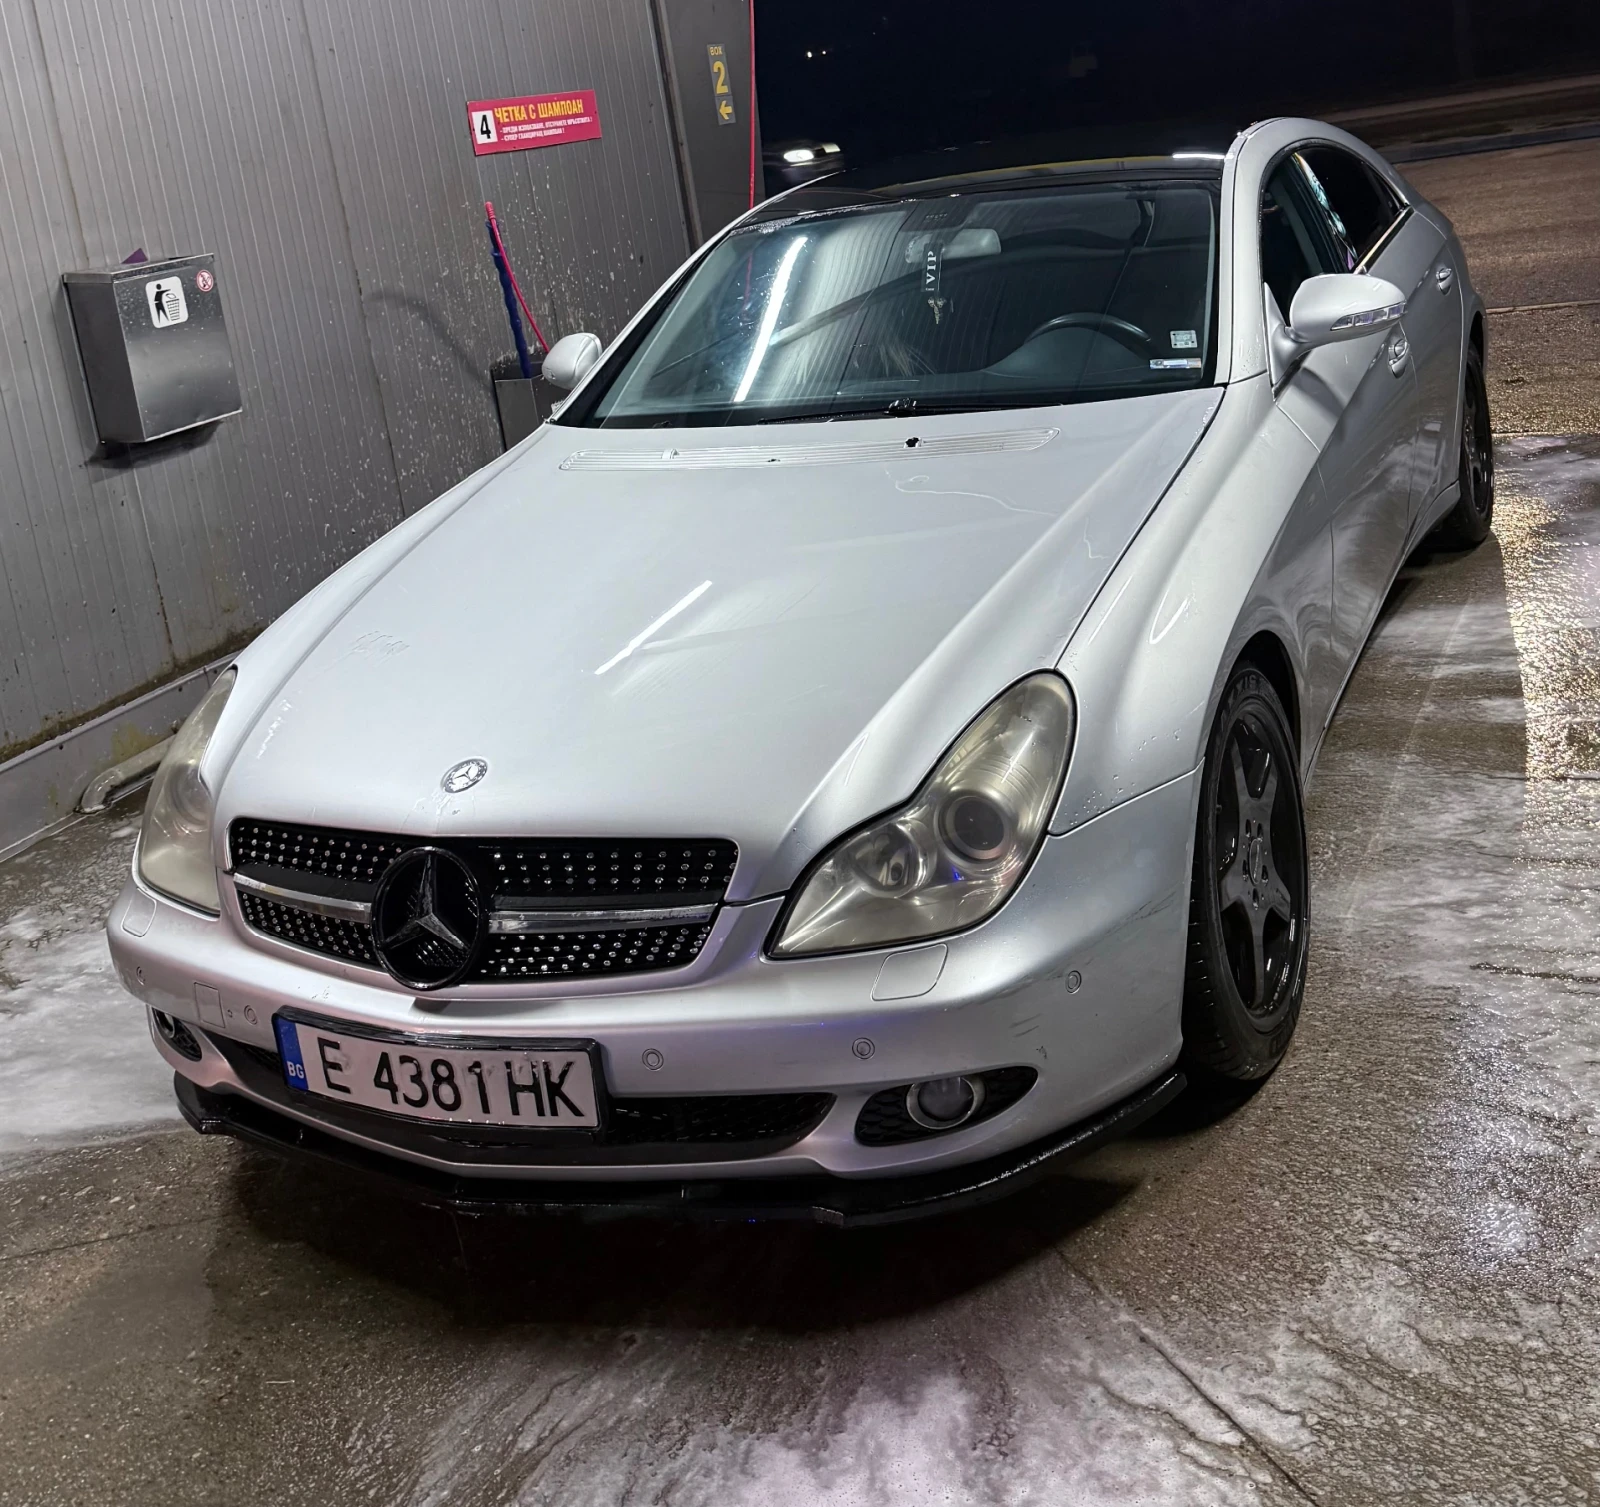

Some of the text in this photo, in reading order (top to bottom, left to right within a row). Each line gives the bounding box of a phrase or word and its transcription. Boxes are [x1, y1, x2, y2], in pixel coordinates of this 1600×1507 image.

[710, 46, 722, 55] BOX
[713, 61, 728, 94] 2
[495, 99, 583, 122] ЧЕТКА С ШАМПОАН
[480, 114, 492, 139] 4
[926, 251, 936, 284] VIP
[287, 1061, 305, 1080] BG
[317, 1037, 585, 1117] E 4381 HK
